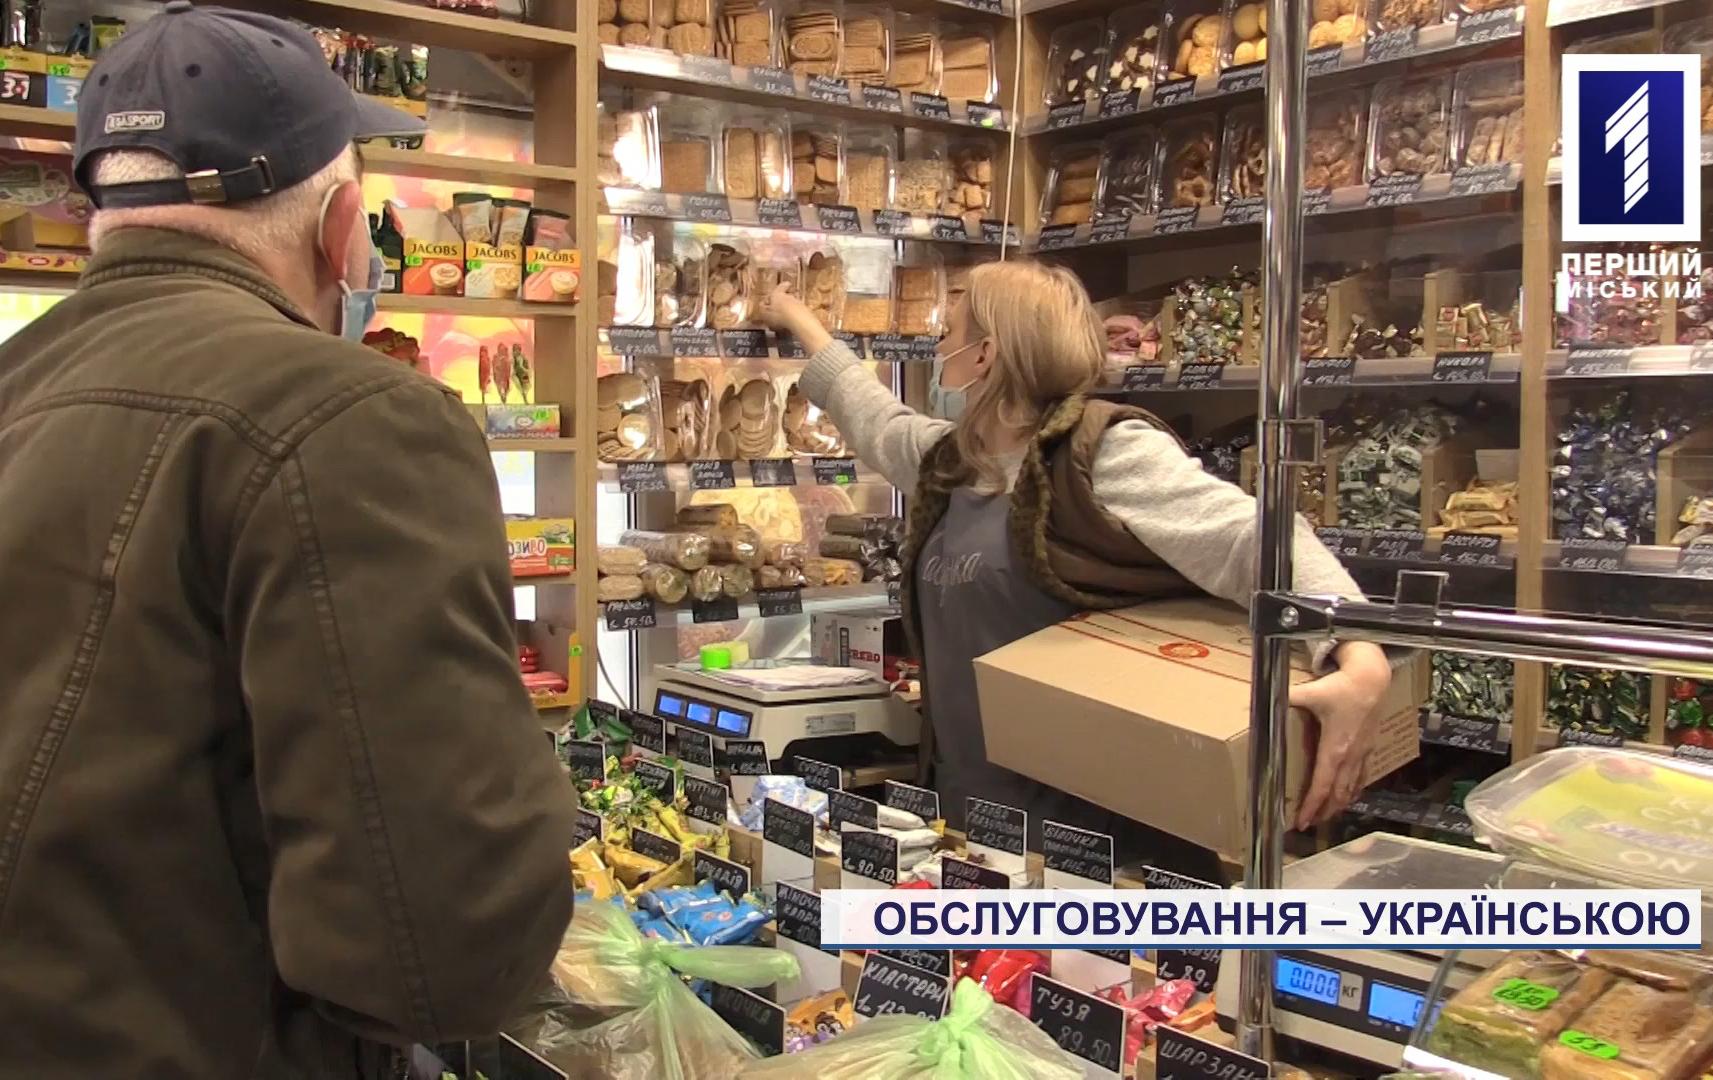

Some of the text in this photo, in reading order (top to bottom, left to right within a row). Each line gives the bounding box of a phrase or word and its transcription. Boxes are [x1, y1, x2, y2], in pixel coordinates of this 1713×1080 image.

[411, 243, 458, 256] JACOBS
[474, 247, 517, 260] JACOBS
[533, 251, 575, 264] JACOBS
[1036, 986, 1091, 1022] ТУЗЯ
